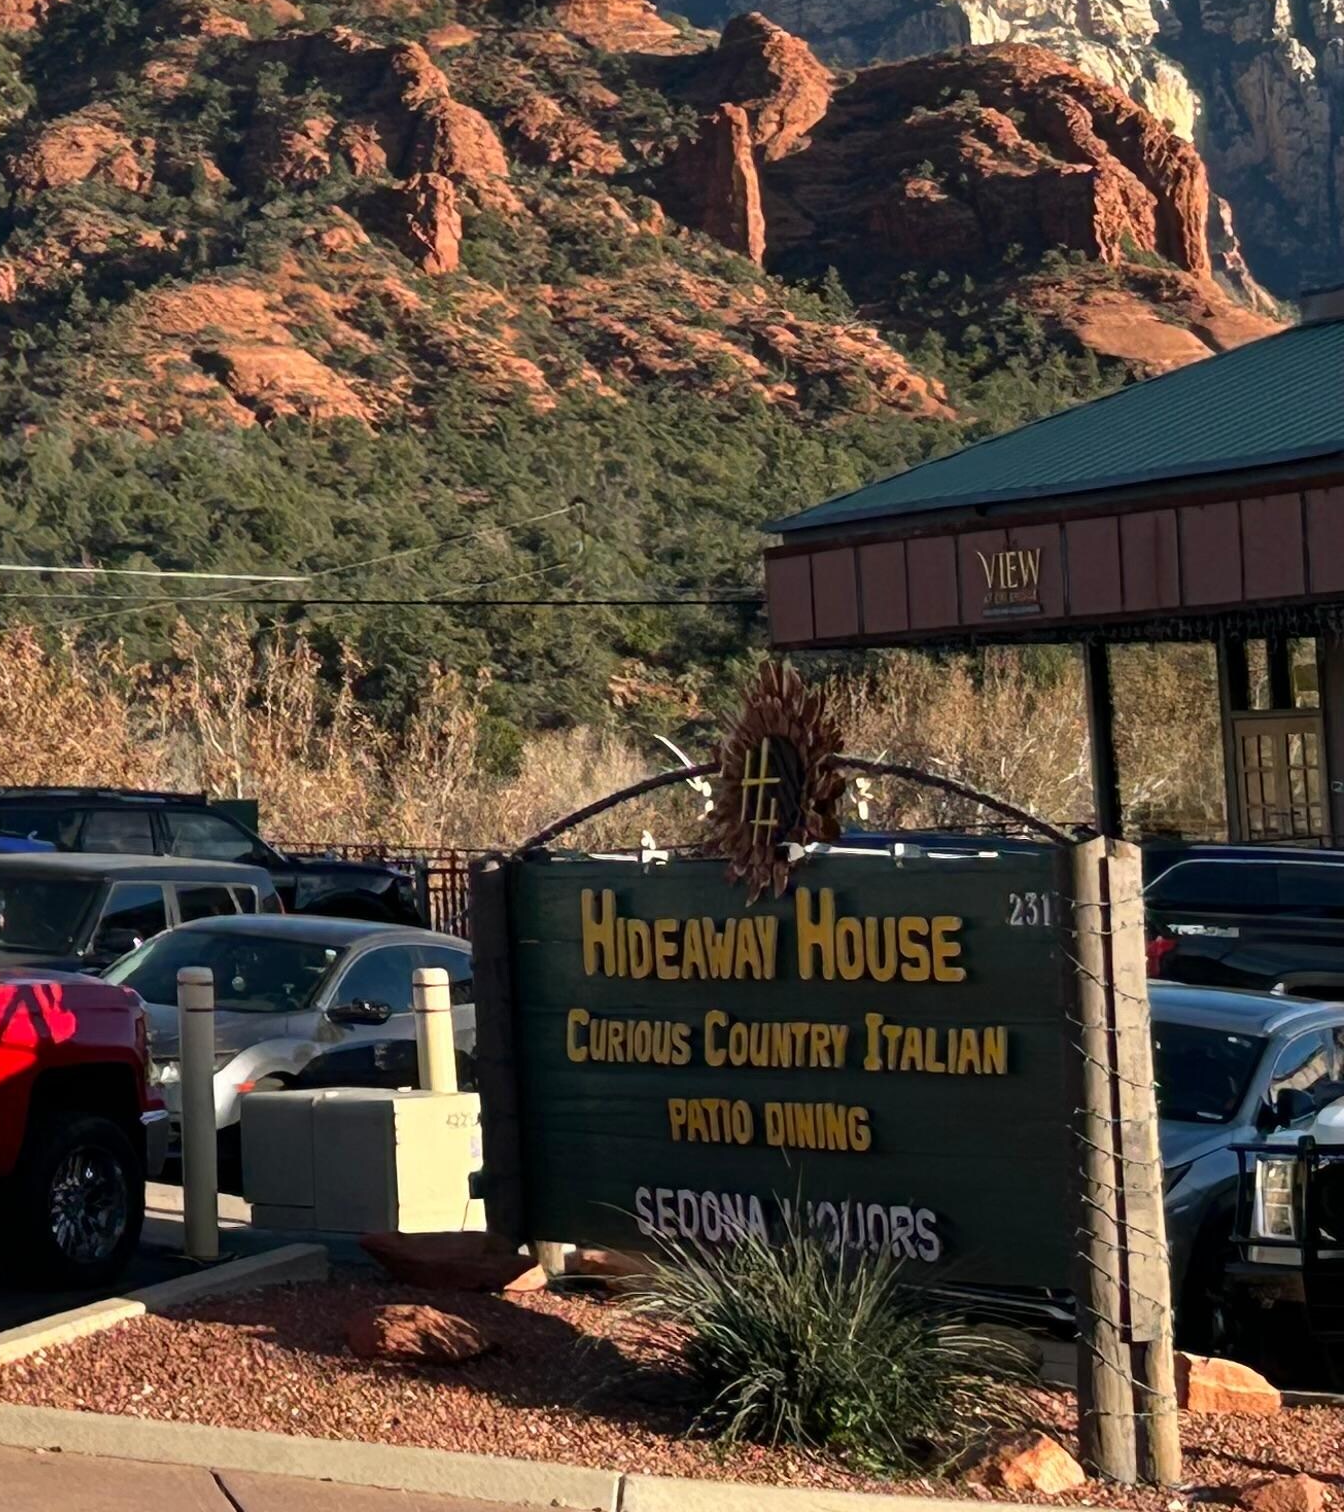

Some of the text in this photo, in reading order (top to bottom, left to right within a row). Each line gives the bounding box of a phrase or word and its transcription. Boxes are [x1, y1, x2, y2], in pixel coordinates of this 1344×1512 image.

[976, 548, 1040, 589] VIEW
[581, 888, 966, 983] HIDEAWAY HOUSE
[1009, 892, 1051, 926] 231
[567, 1008, 1009, 1075] CURIOUS COUNTRY ITALIAN
[668, 1098, 872, 1152] PATIO DINING
[635, 1186, 767, 1243] SEDONA
